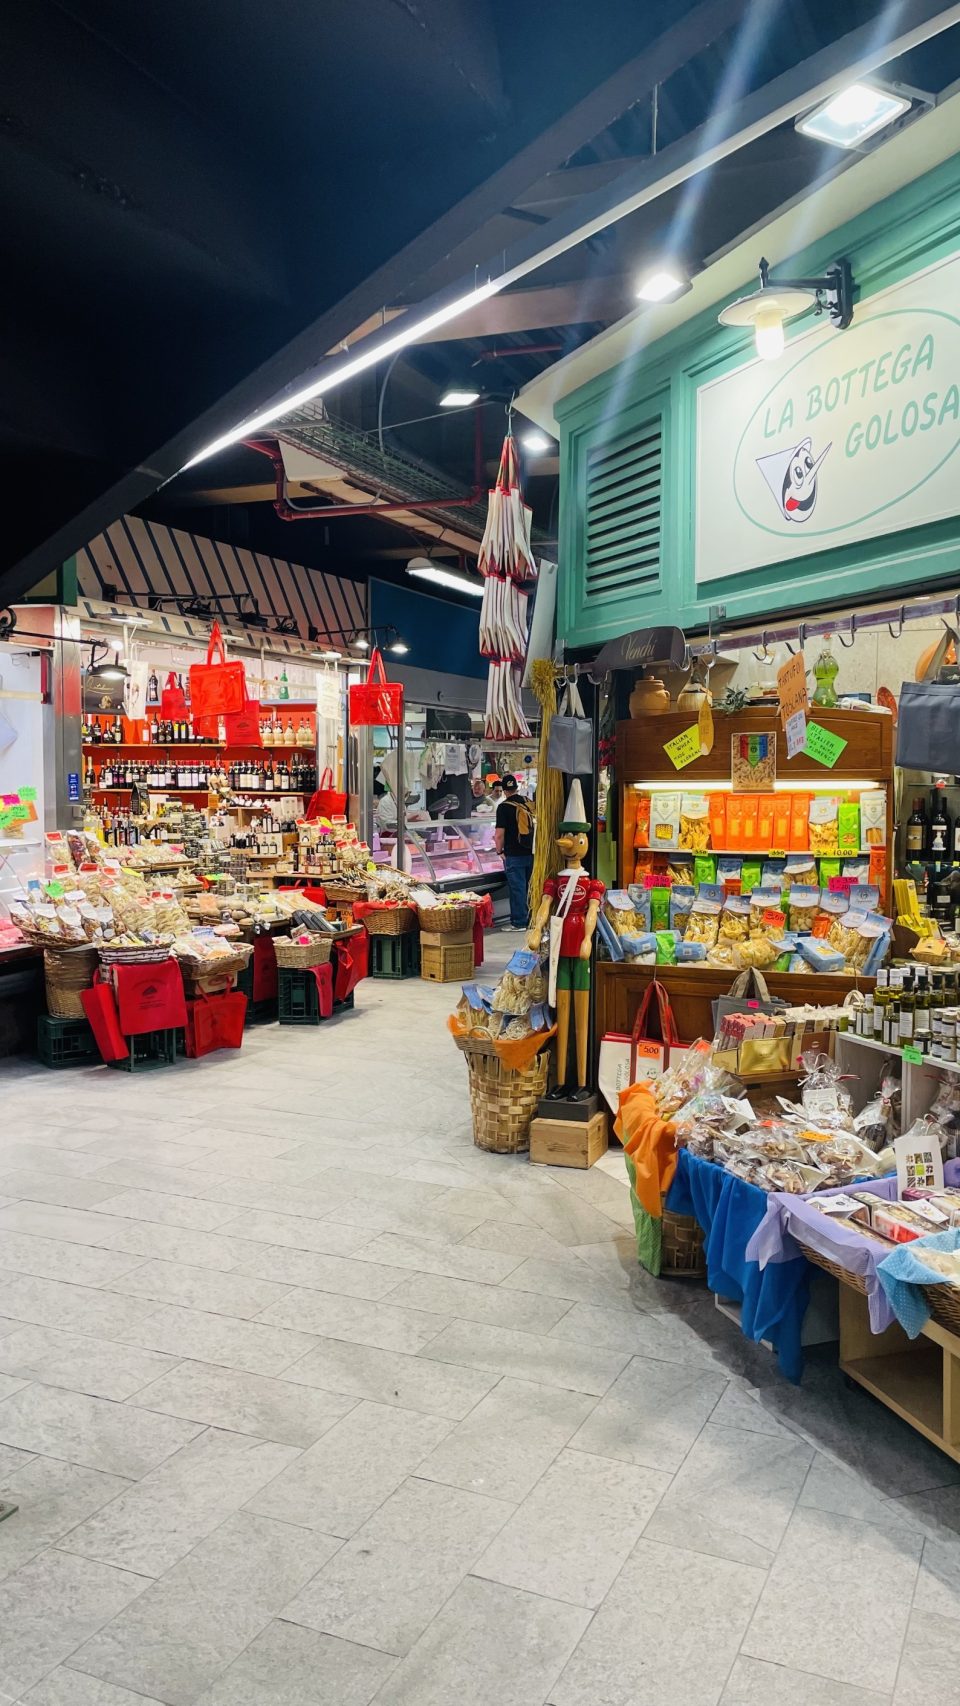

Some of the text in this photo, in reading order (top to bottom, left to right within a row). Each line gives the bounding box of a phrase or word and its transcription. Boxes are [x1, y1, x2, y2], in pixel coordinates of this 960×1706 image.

[763, 334, 935, 438] LA BOTTEGA
[844, 384, 960, 458] GOLOSA
[621, 632, 657, 661] Venchi
[666, 733, 689, 750] ITALIAN
[676, 736, 694, 751] WHEAT
[680, 749, 702, 764] FLORENC
